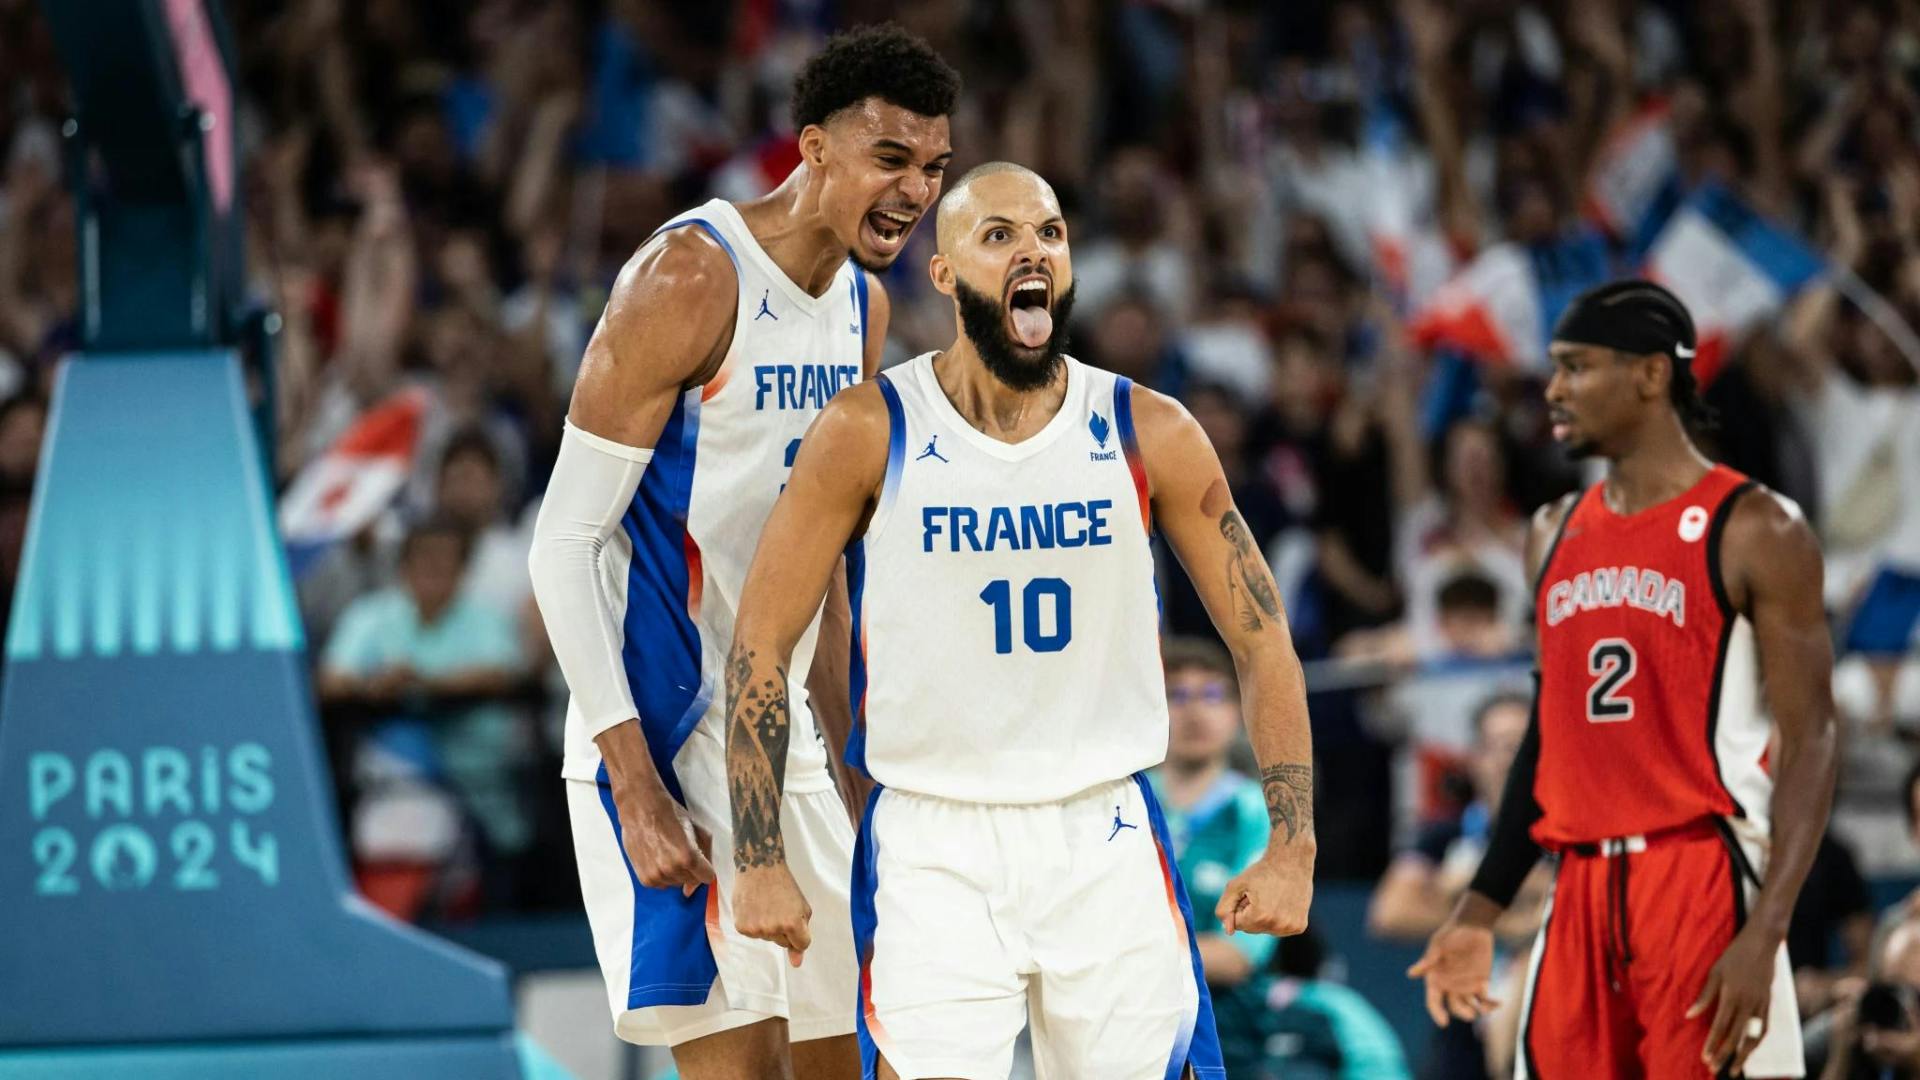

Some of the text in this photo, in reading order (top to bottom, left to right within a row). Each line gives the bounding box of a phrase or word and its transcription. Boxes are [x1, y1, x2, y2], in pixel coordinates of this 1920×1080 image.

[1090, 450, 1117, 461] FRANCE
[922, 499, 1112, 552] FRANCE
[979, 577, 1072, 654] 10
[1547, 566, 1685, 627] CANADA
[1586, 637, 1637, 723] 2
[33, 819, 279, 895] 2024
